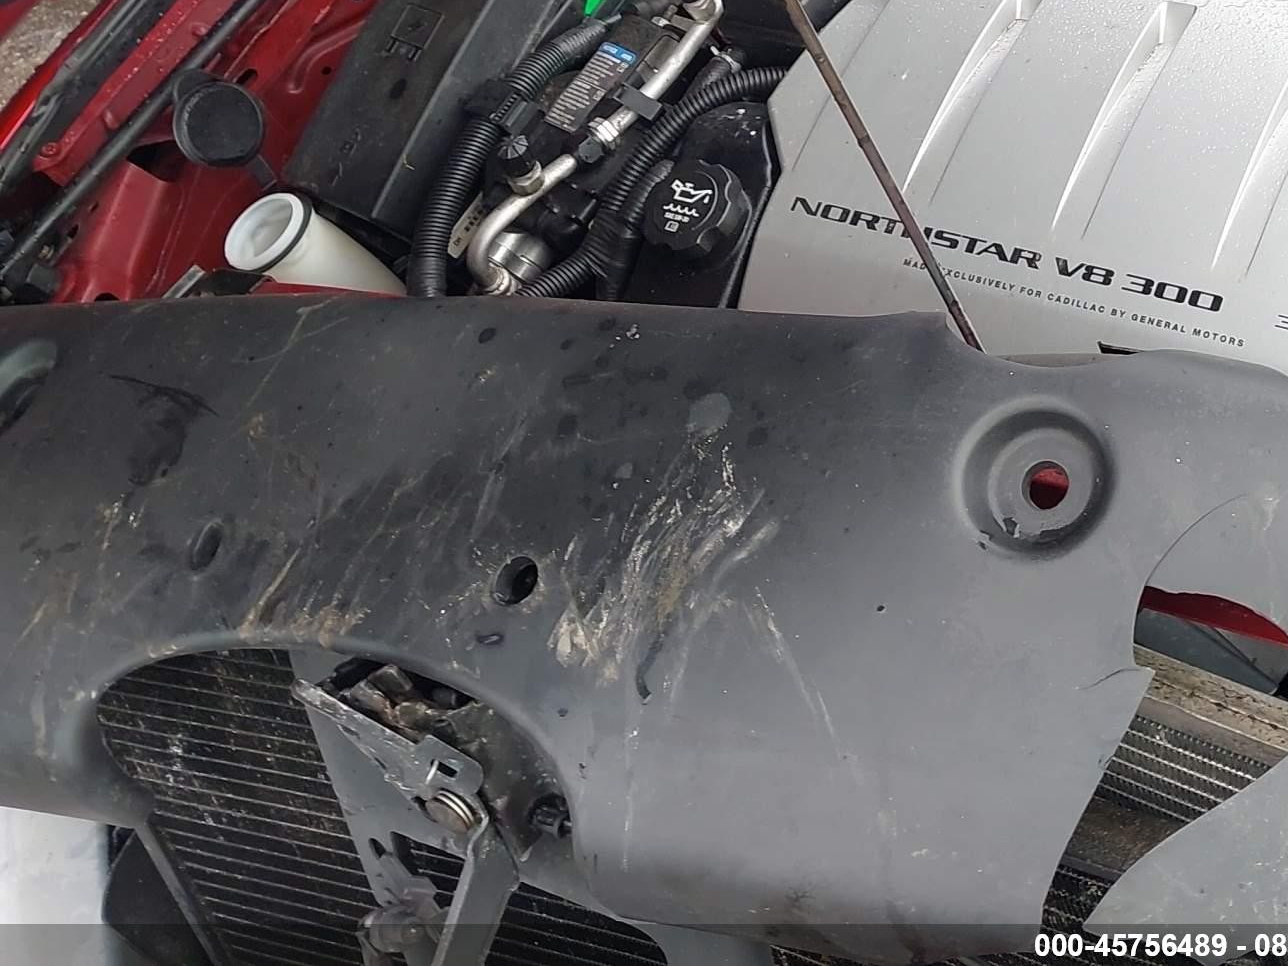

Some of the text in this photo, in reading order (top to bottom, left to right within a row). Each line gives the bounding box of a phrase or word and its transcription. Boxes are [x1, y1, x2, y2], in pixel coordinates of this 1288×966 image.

[903, 258, 928, 271] MAD
[1019, 286, 1043, 299] FOR
[1047, 293, 1105, 314] CADILLAC
[1110, 309, 1126, 319] BY
[1131, 313, 1187, 334] GENERAL
[1193, 328, 1245, 347] MOTORS
[1055, 256, 1115, 286] V8
[1120, 273, 1224, 313] 300
